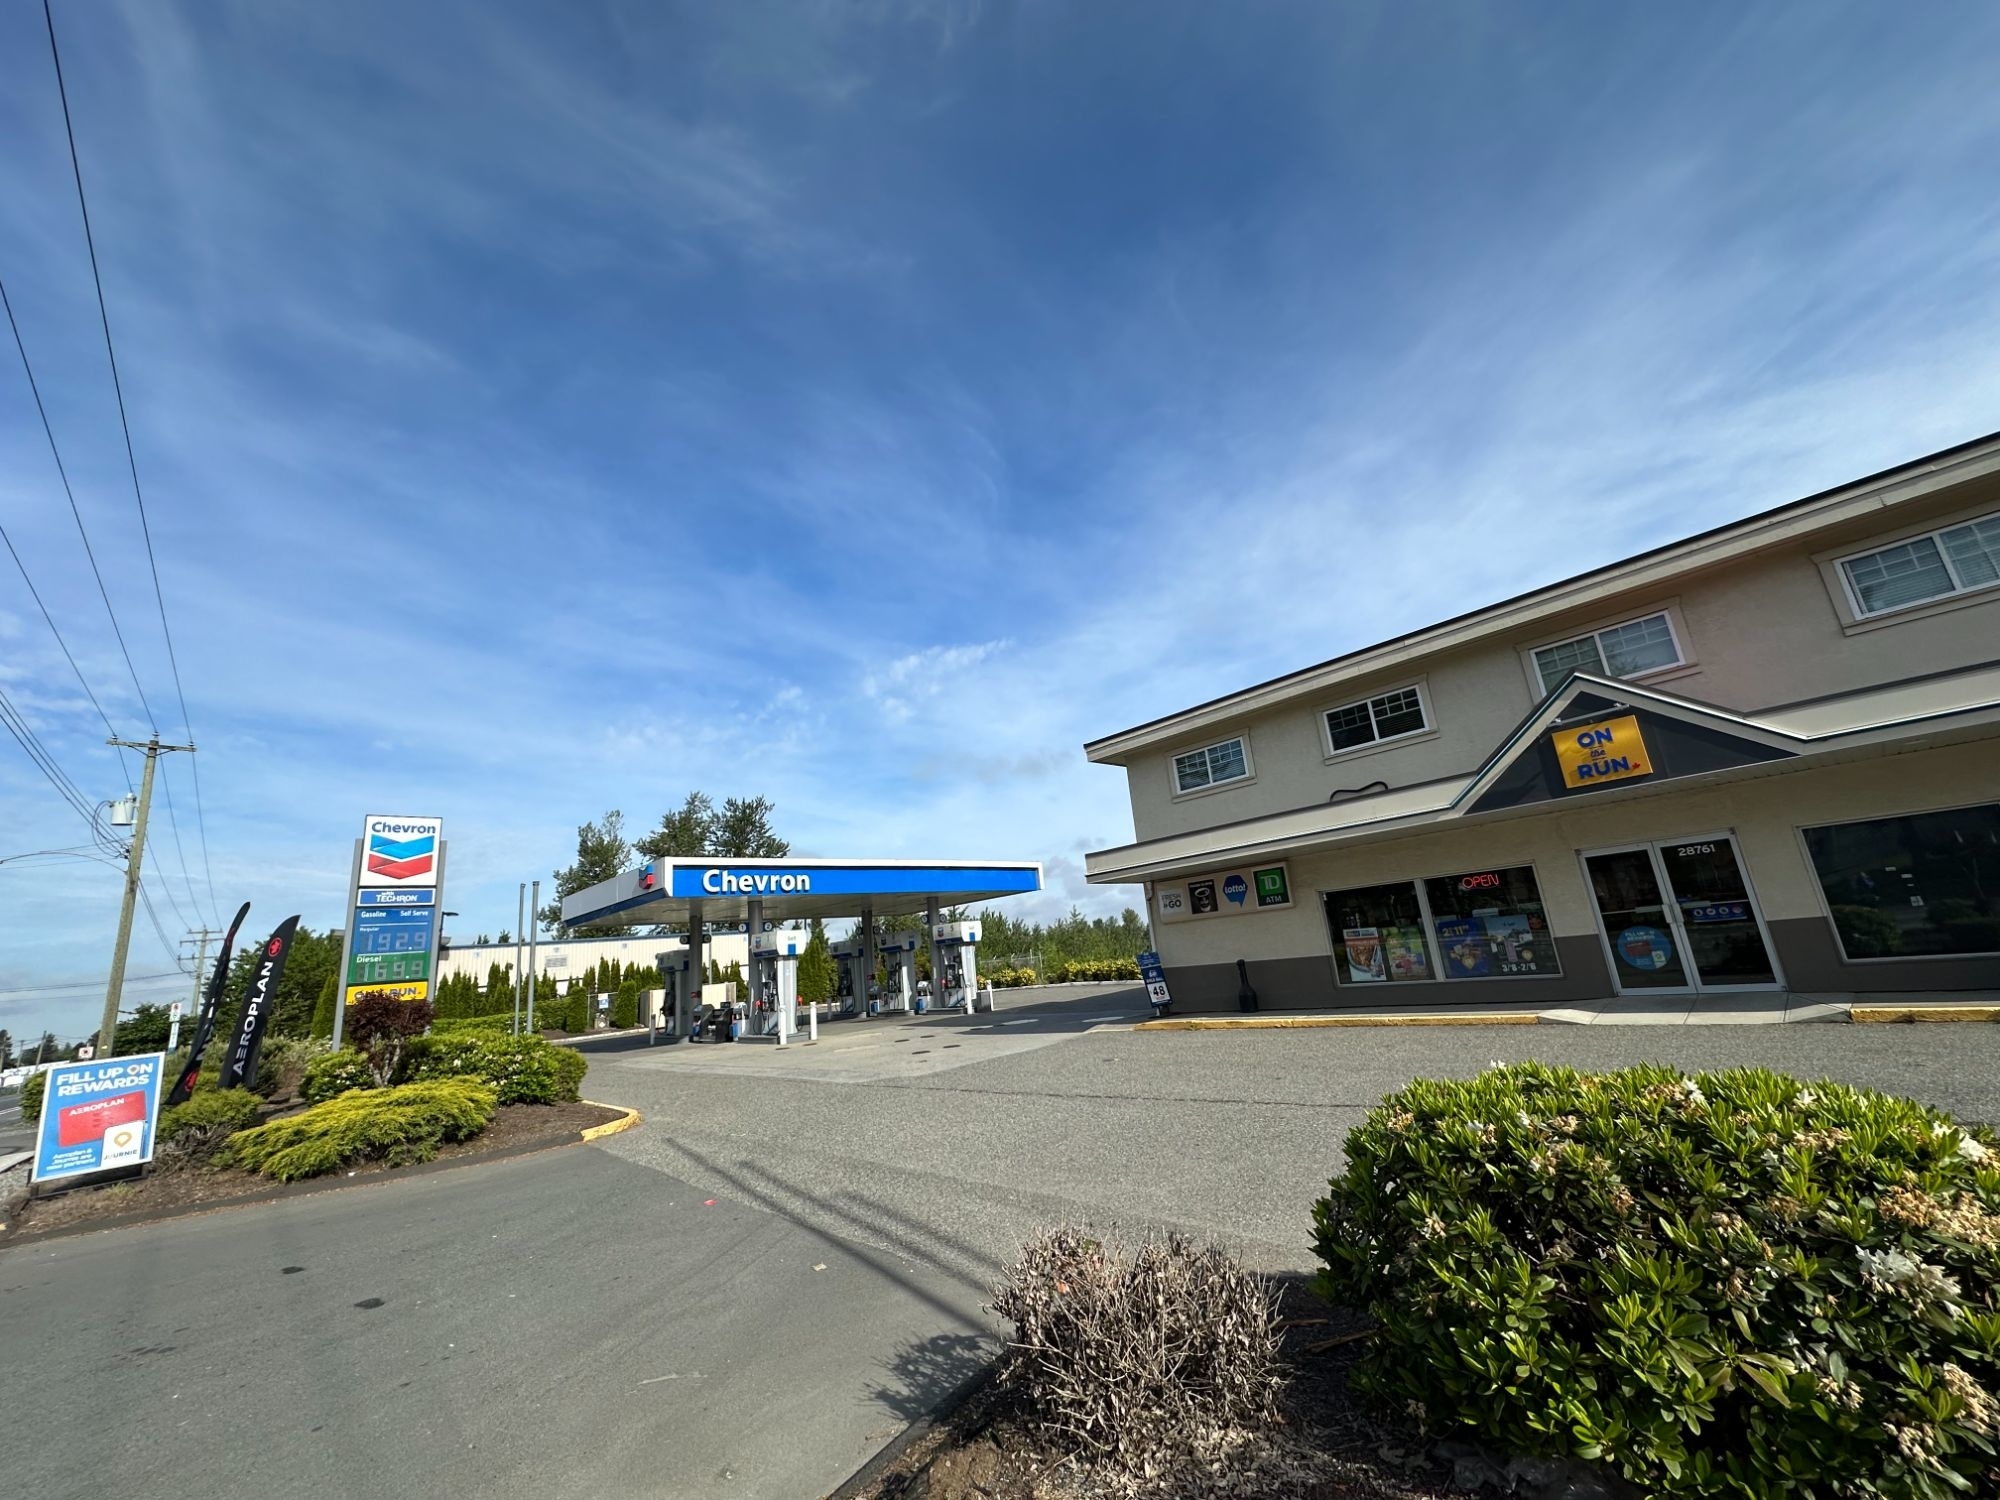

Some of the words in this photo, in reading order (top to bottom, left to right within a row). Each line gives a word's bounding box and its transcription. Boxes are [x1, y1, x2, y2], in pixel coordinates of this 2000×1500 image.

[1576, 727, 1613, 748] ON
[1590, 748, 1606, 758] the
[1577, 756, 1630, 780] RUN
[371, 821, 436, 834] Chevron
[1678, 844, 1716, 857] 28761
[703, 868, 811, 894] Chevron
[1260, 873, 1281, 889] TD
[1462, 873, 1499, 889] OPEN
[1224, 883, 1247, 894] lotto!
[375, 894, 418, 905] TECHRON
[1168, 900, 1182, 909] GO
[1265, 895, 1282, 904] ATM
[360, 910, 387, 919] Gasoline
[400, 909, 411, 917] Self
[412, 909, 429, 917] Serve
[356, 955, 382, 964] Diesel
[232, 961, 273, 1076] AEROPLAN
[57, 1069, 96, 1087] FILL
[98, 1065, 123, 1079] UP
[127, 1062, 153, 1077] ON
[57, 1075, 150, 1097] REWARDS
[68, 1098, 125, 1117] AEROPLAN
